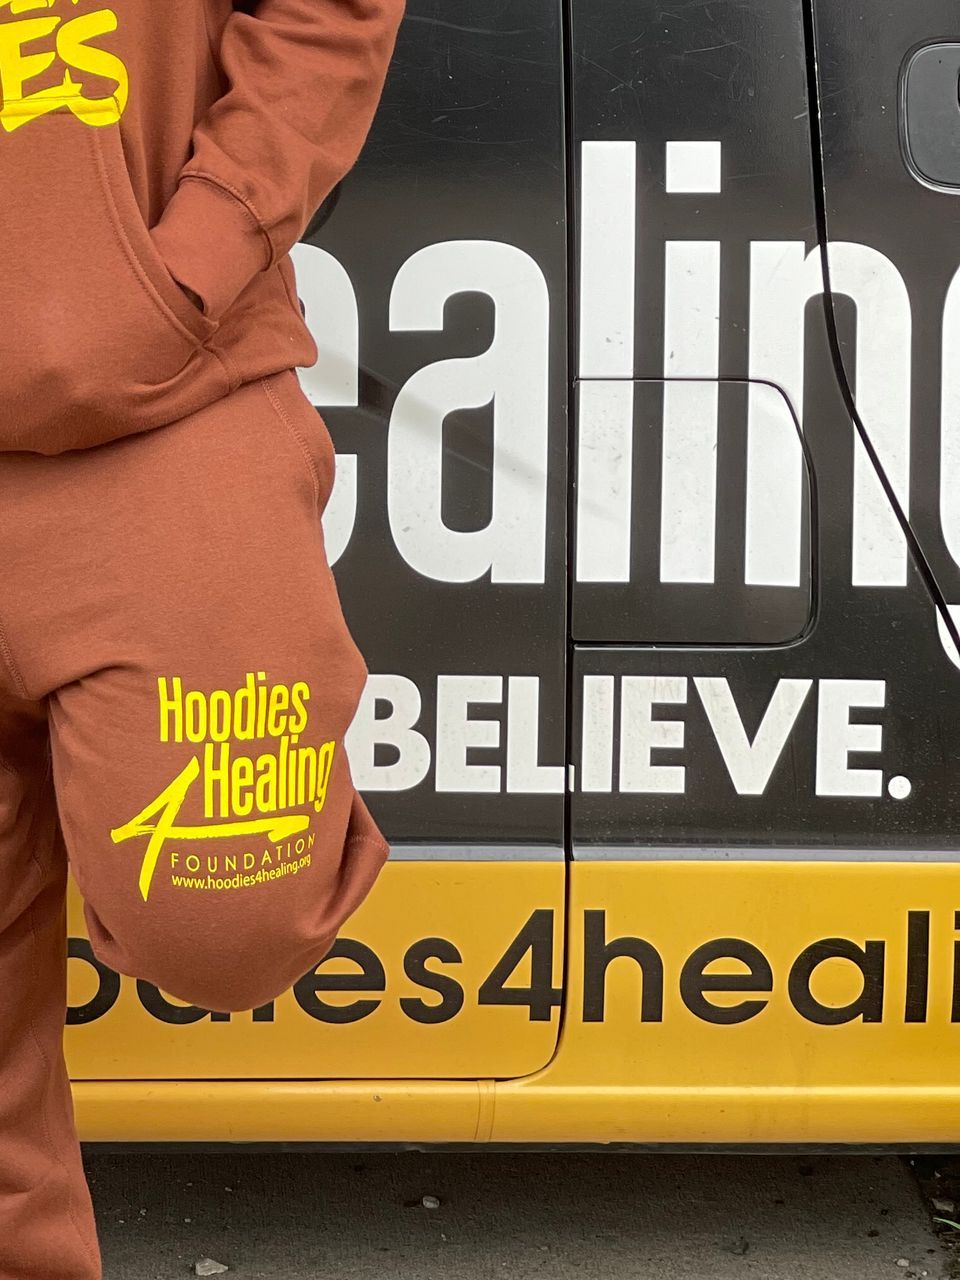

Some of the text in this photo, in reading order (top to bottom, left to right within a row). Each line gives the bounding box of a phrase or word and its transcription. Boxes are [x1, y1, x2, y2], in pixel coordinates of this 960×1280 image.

[157, 671, 311, 744] Hoodies
[344, 674, 912, 800] BELIEVE.
[204, 735, 336, 819] Healing
[170, 833, 315, 873] FOUNDATION
[171, 853, 311, 890] www.hoodies4healing.org
